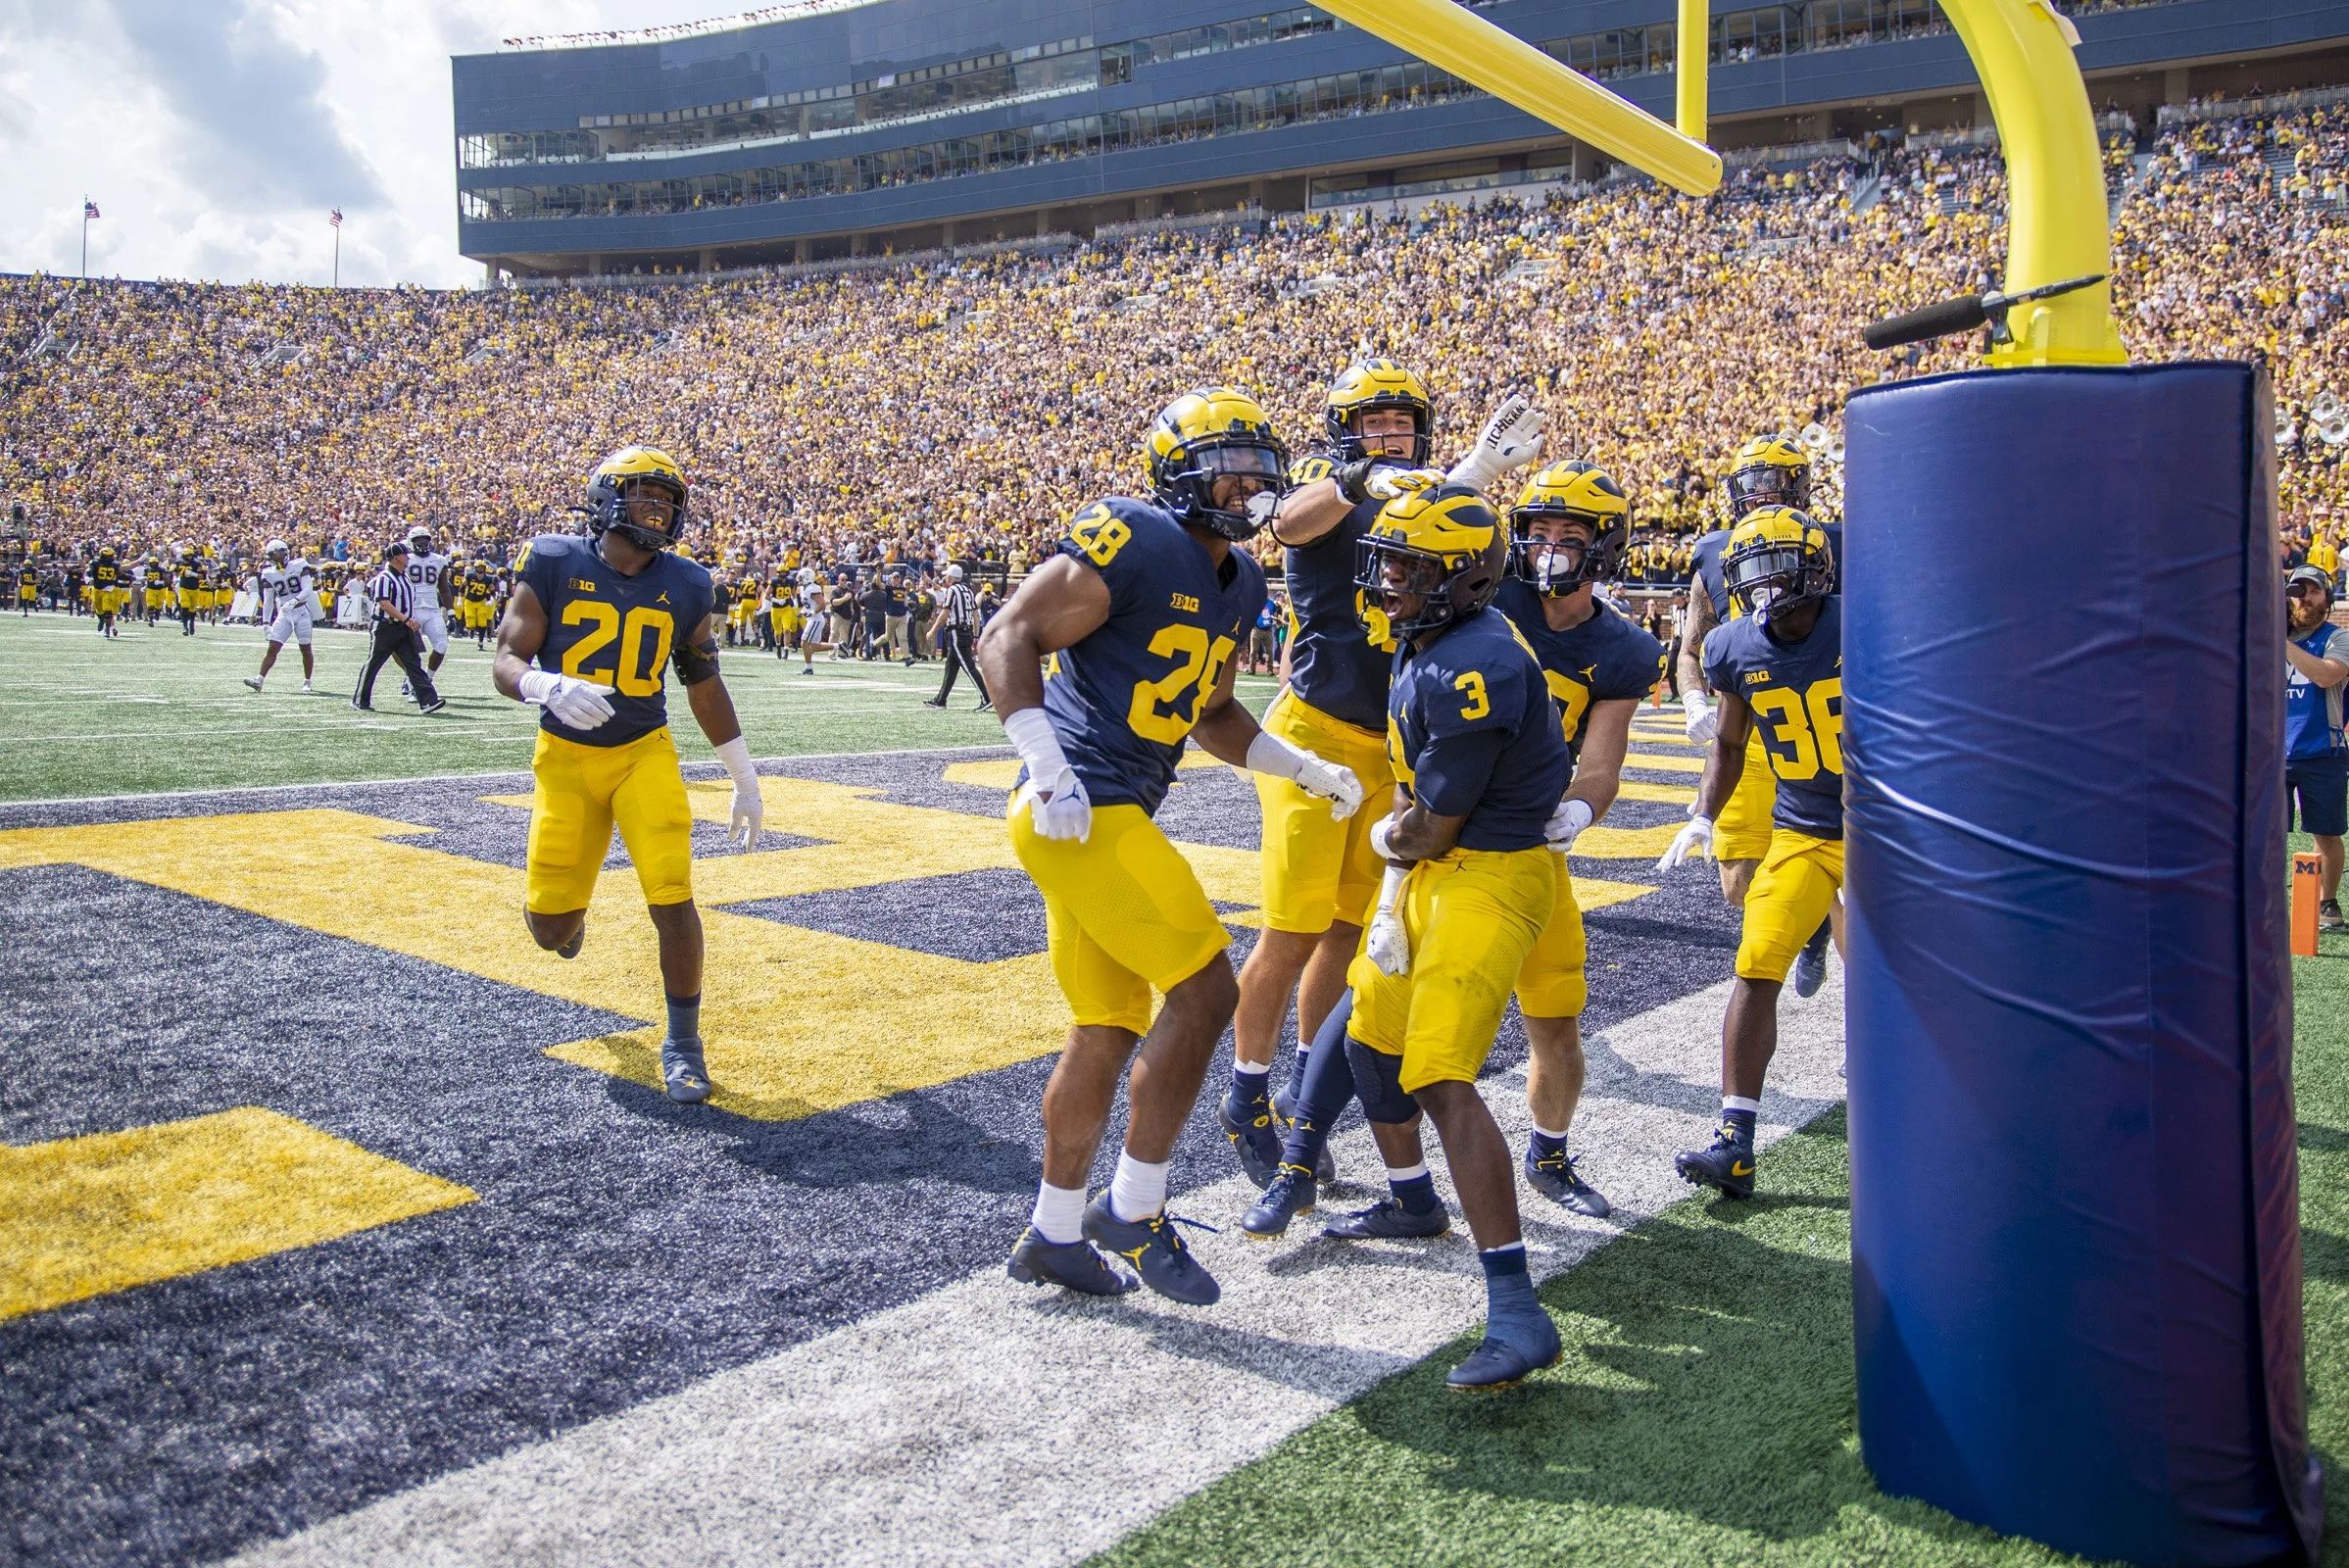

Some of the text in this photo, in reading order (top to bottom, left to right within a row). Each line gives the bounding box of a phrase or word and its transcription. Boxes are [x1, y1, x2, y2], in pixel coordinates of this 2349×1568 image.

[1289, 456, 1333, 485] 40
[1070, 503, 1132, 566] 28
[410, 564, 438, 585] 96
[274, 575, 302, 597] 29
[469, 581, 487, 596] 79
[741, 579, 757, 595] 72
[343, 600, 352, 617] Z
[562, 599, 674, 698] 20
[1455, 670, 1491, 721] 3
[2295, 859, 2316, 875] M
